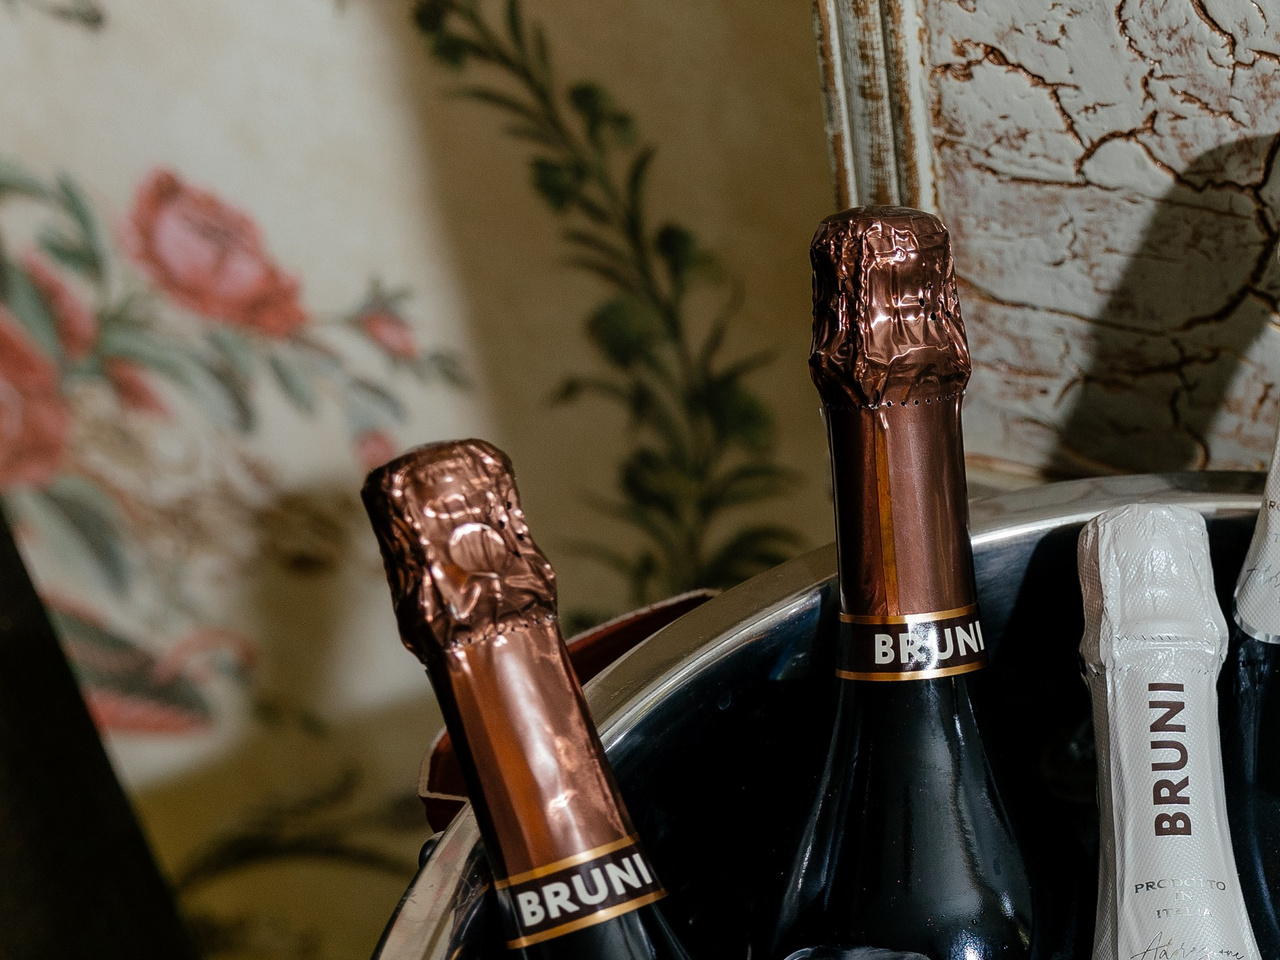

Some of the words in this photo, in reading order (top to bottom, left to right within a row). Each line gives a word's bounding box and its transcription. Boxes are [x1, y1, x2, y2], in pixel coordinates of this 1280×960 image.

[874, 620, 985, 665] BRUNI
[1148, 682, 1192, 837] BRUNI
[517, 853, 653, 927] BRUNI
